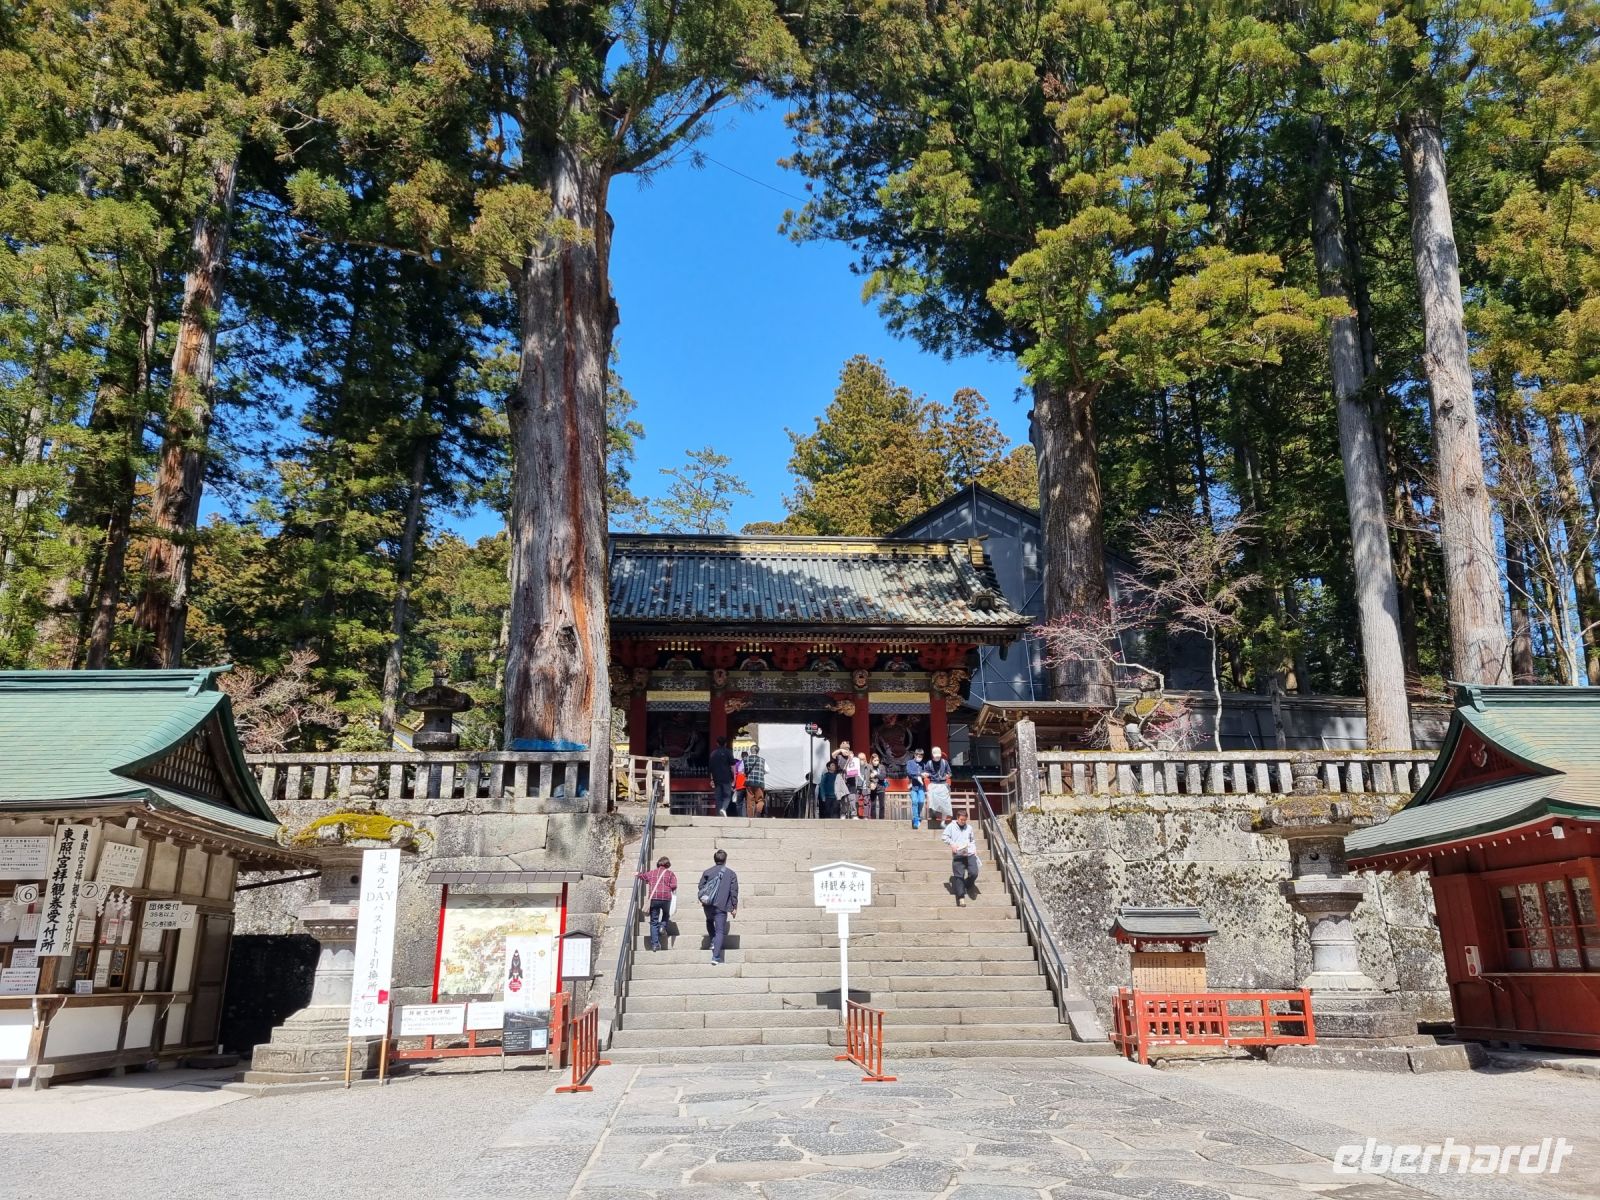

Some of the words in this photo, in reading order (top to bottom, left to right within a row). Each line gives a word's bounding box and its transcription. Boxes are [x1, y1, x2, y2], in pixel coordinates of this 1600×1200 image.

[40, 827, 75, 954] 東照宮拝観券受付所
[148, 902, 180, 911] 団体受付
